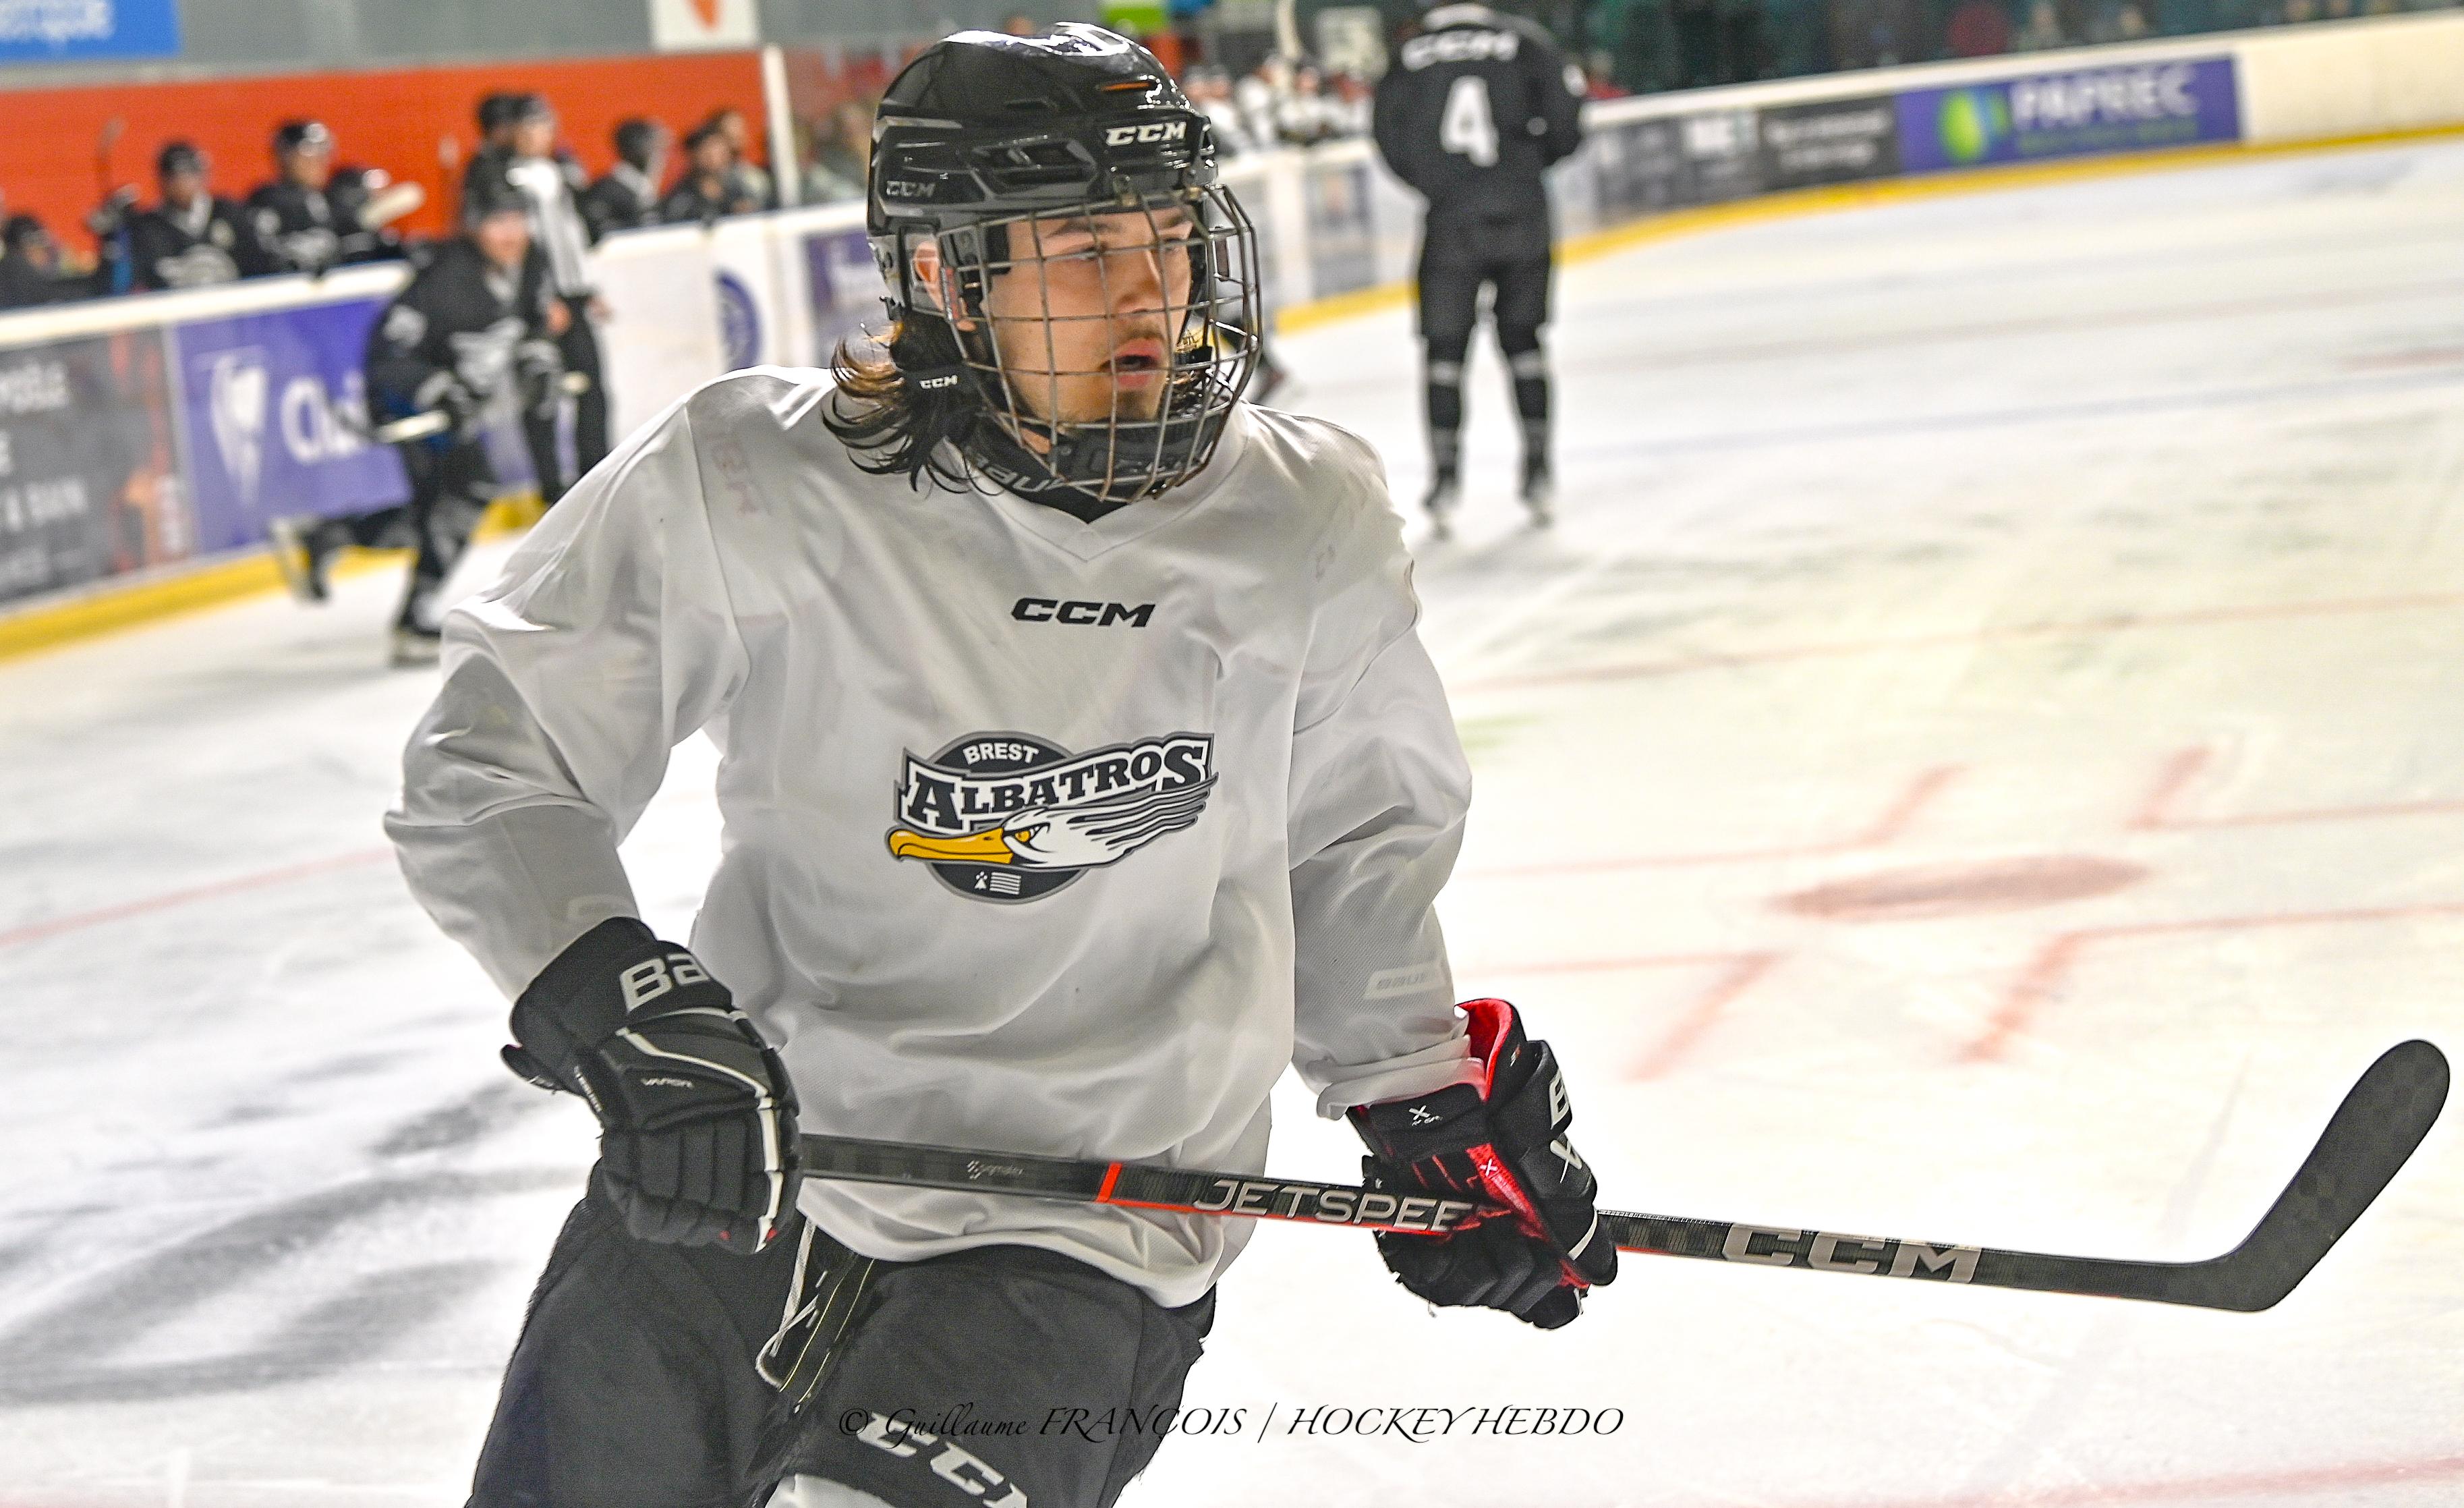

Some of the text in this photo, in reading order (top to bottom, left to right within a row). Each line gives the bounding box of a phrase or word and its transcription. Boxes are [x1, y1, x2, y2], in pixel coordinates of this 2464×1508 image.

[1106, 121, 1187, 146] CCM
[1439, 75, 1499, 167] 4
[886, 180, 936, 198] CCM
[919, 374, 958, 389] CCM
[1012, 598, 1155, 627] CCM
[963, 742, 1039, 765] BREST
[908, 745, 1204, 831] ALBATROS
[1193, 1179, 1473, 1232] JETSPEE
[1722, 1223, 1982, 1284] CCM
